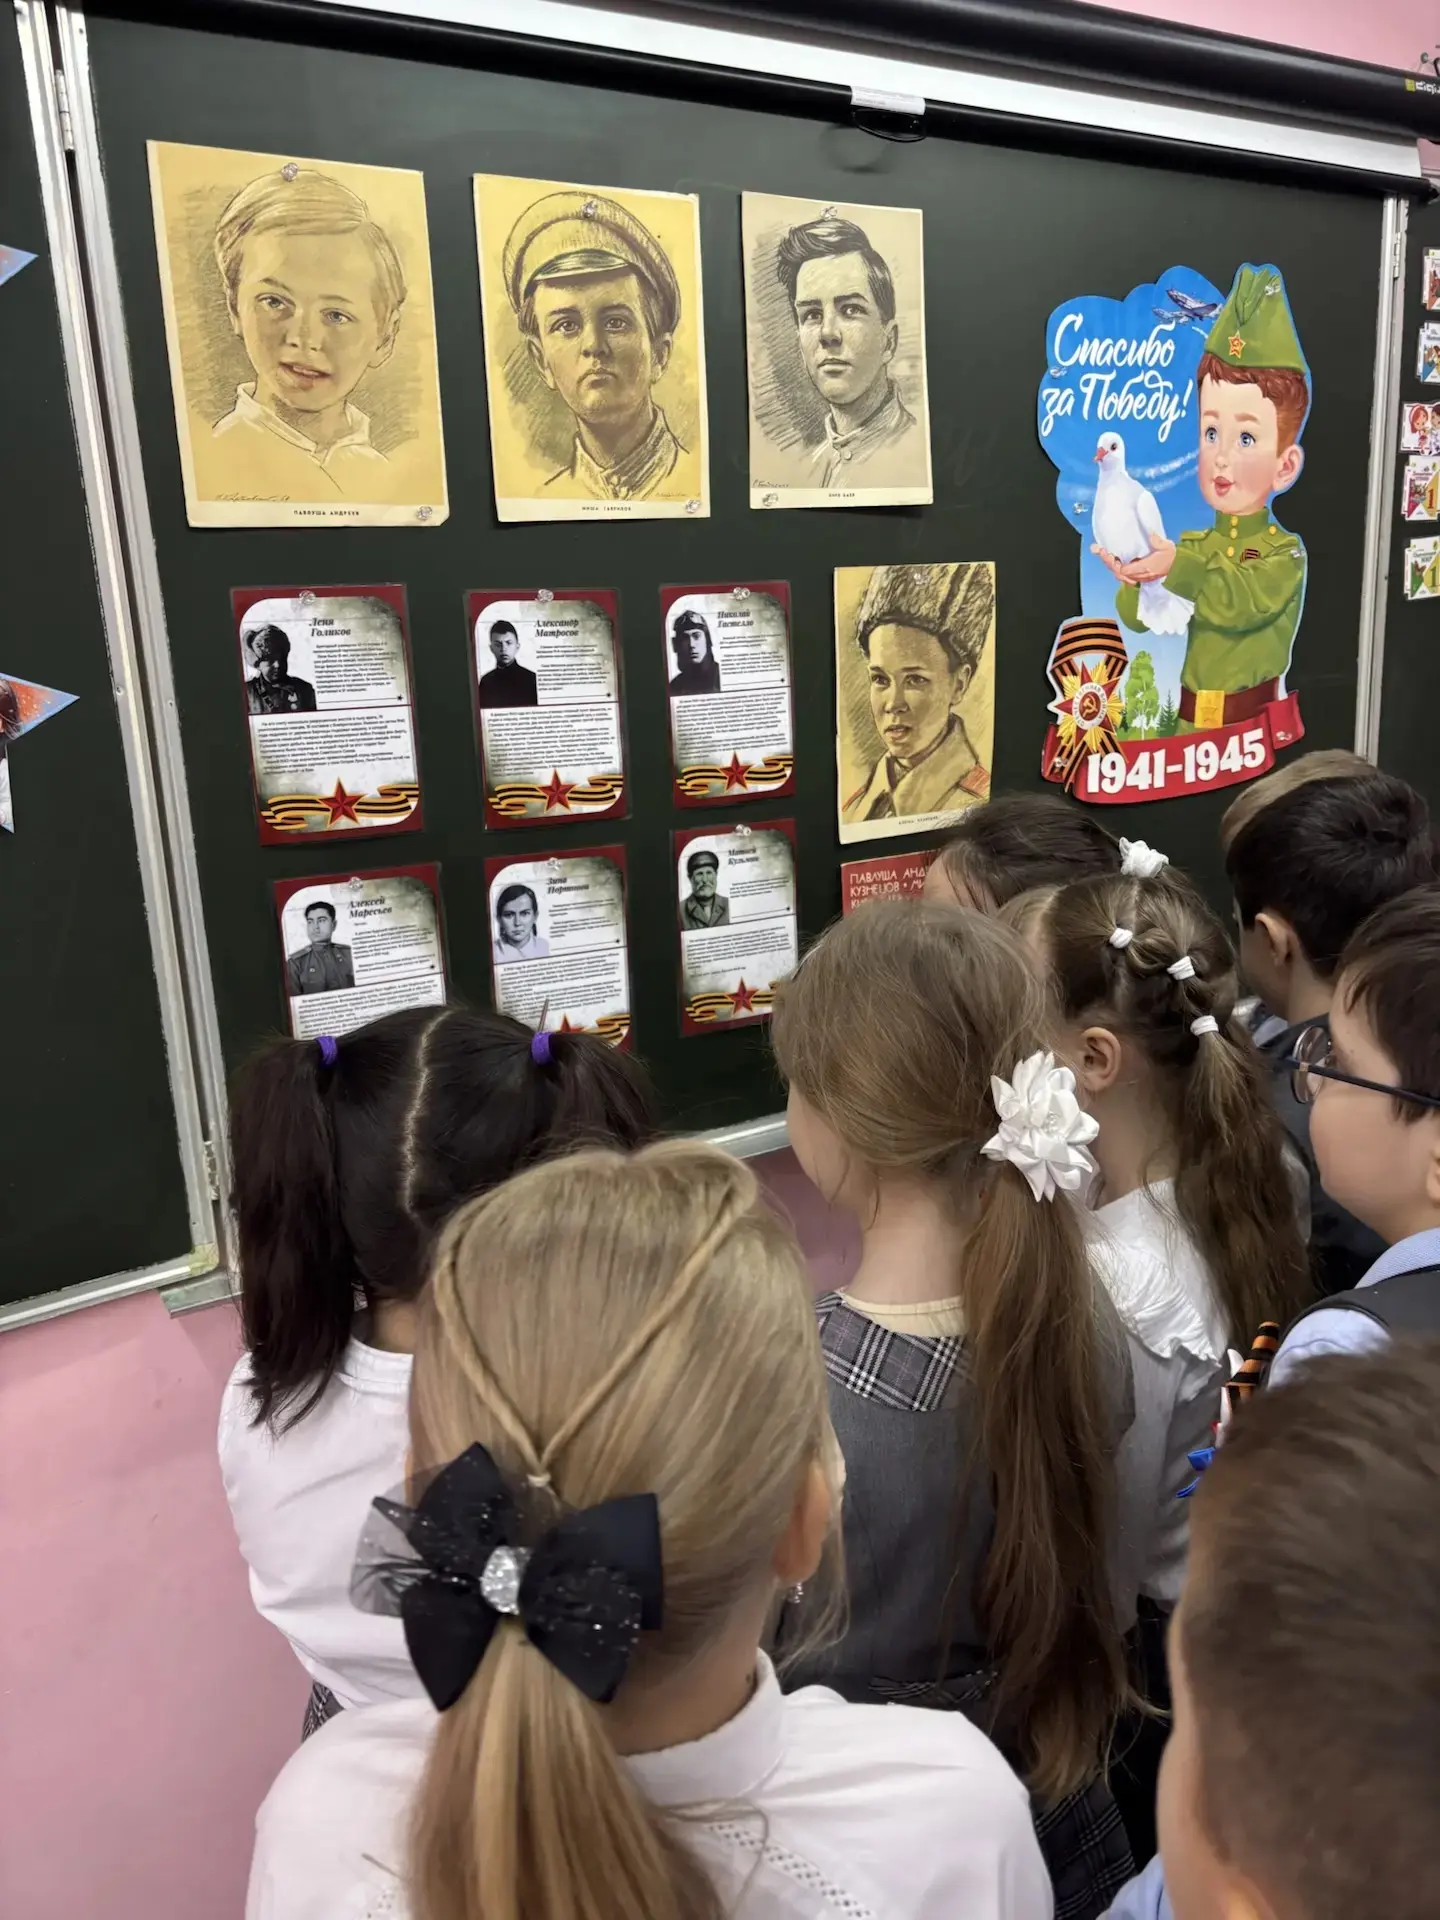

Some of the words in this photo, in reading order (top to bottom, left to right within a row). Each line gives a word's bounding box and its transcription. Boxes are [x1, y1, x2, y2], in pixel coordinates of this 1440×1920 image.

[1054, 312, 1176, 368] Спасибо
[1040, 386, 1077, 437] за
[1079, 368, 1194, 443] Победу!
[310, 627, 352, 638] Голиков
[533, 619, 580, 630] Александр
[534, 628, 580, 639] Матросов
[1086, 728, 1267, 794] 1941-1945
[849, 869, 898, 886] ПАВЛУША
[902, 866, 928, 879] АНД
[849, 881, 900, 898] КУЗНЕЦОВ
[909, 879, 925, 892] МИ
[348, 895, 386, 911] Алексей
[349, 906, 393, 921] Маресьев
